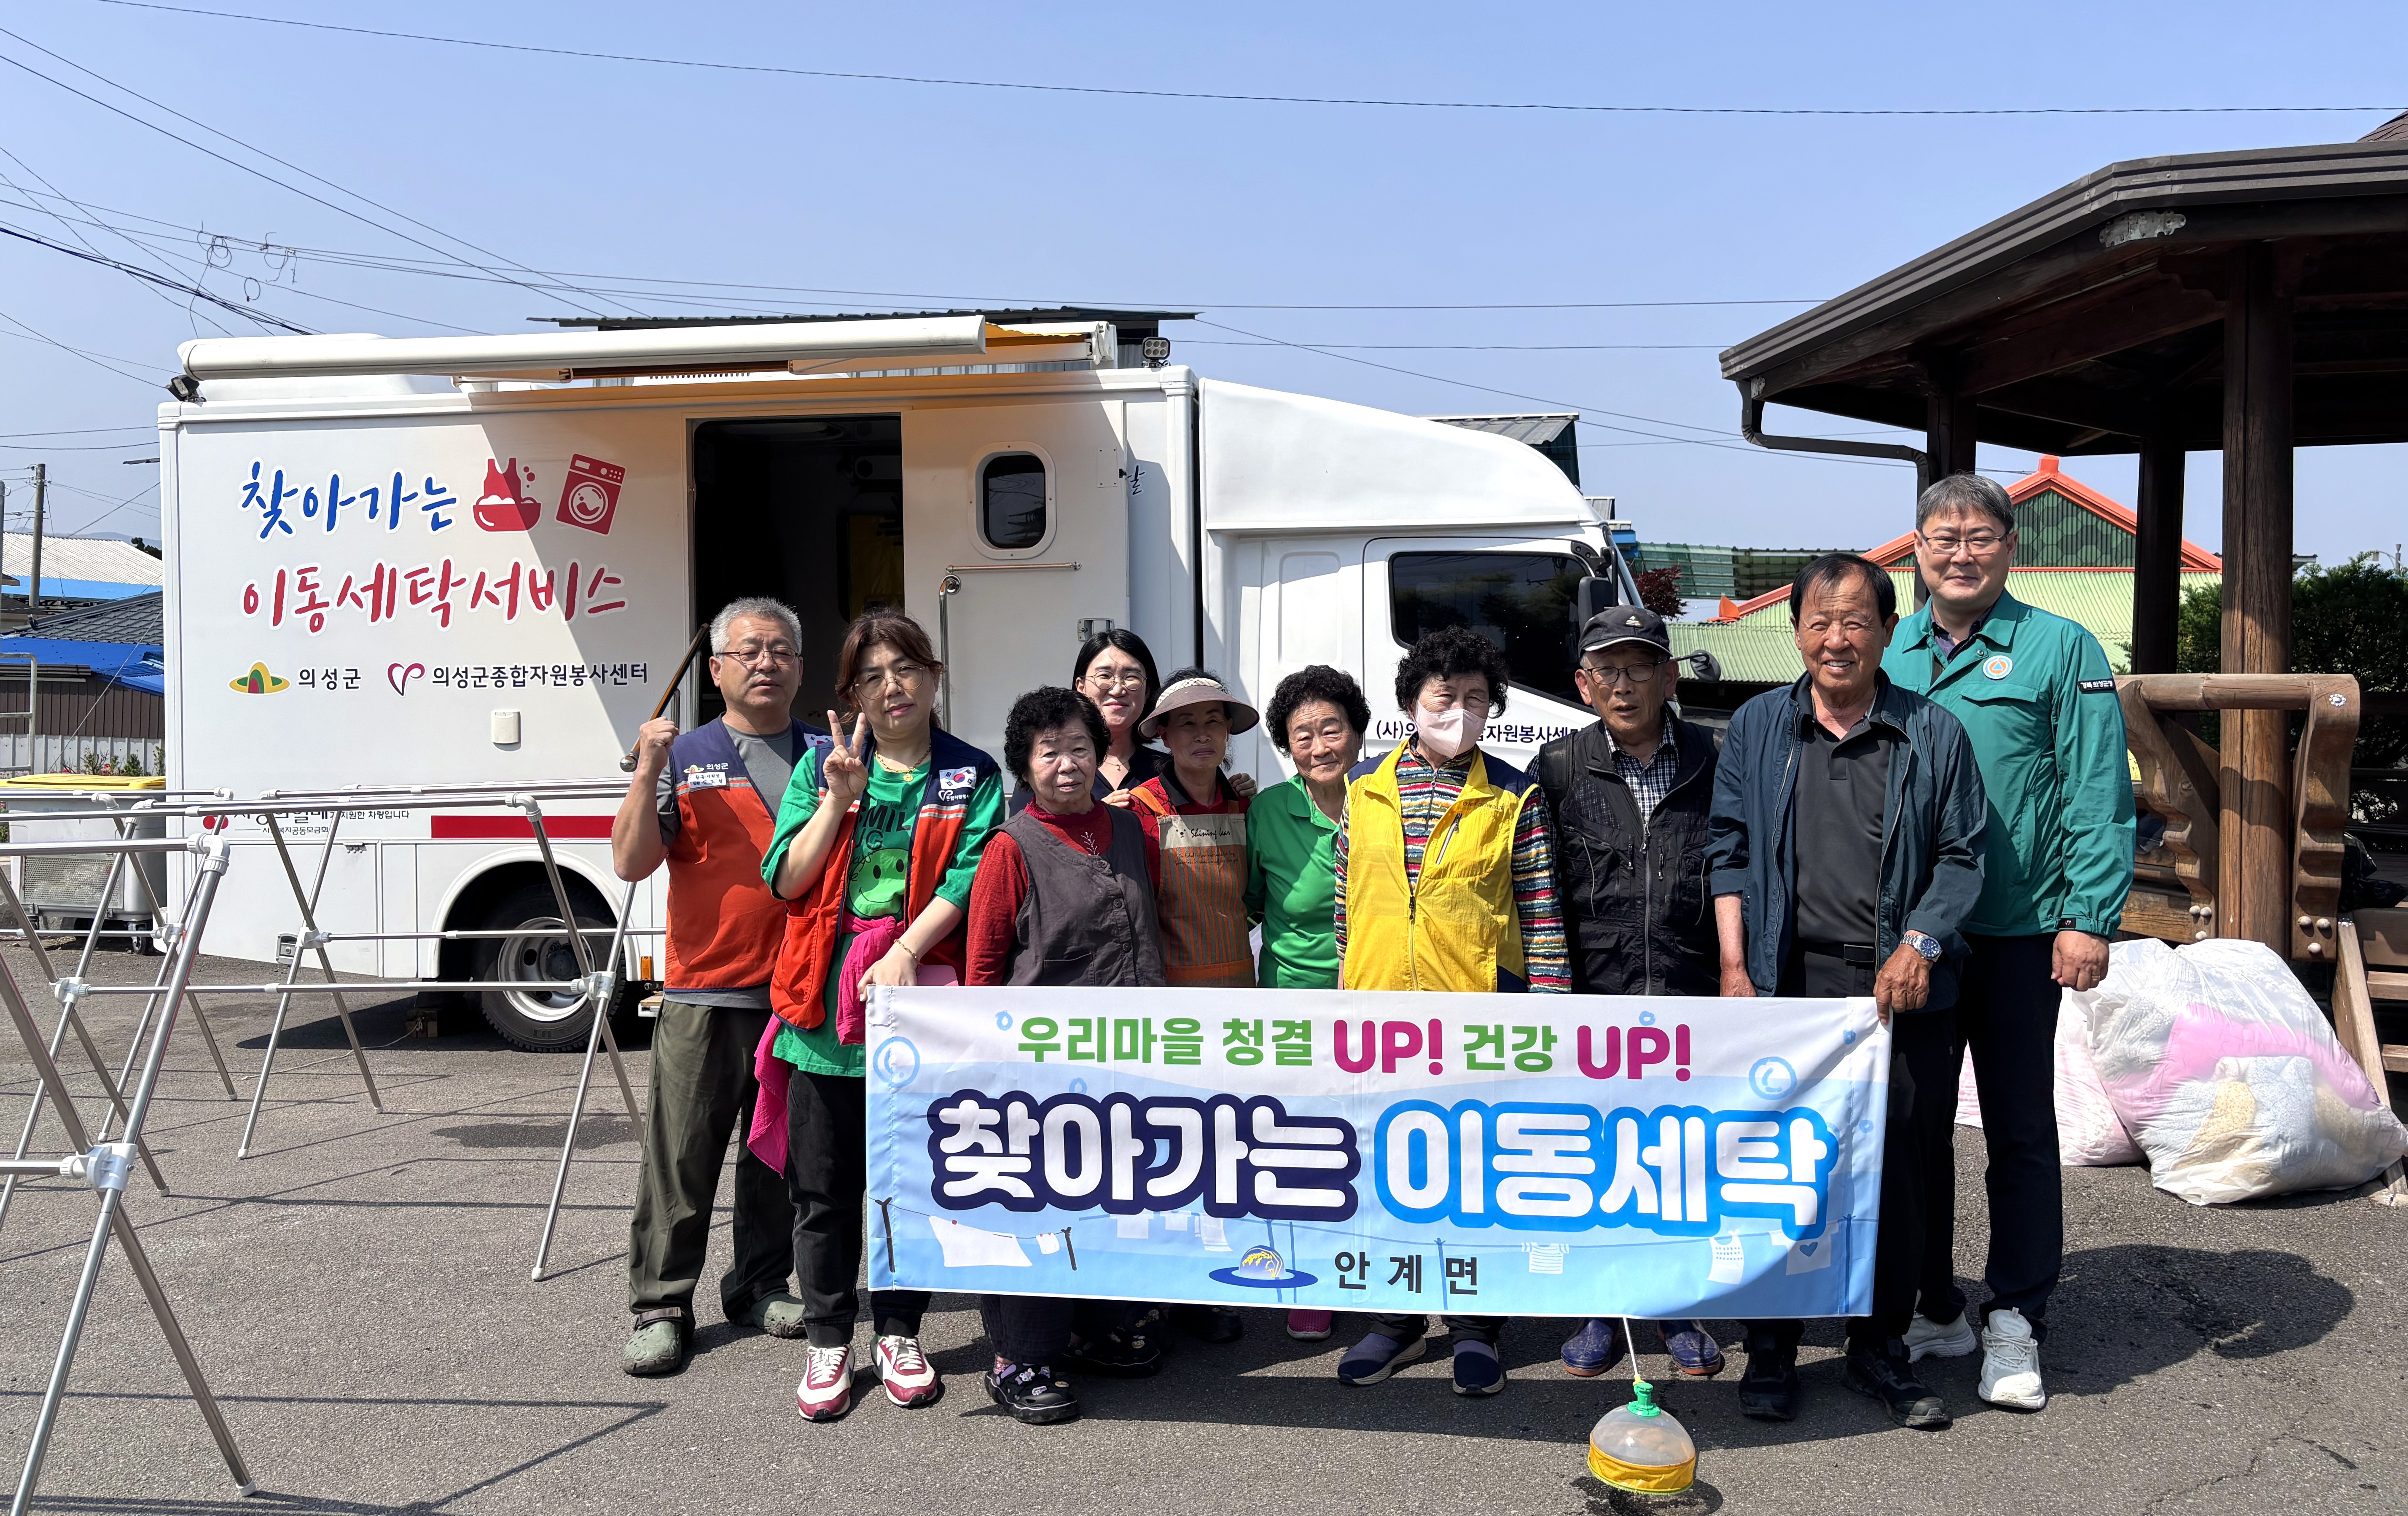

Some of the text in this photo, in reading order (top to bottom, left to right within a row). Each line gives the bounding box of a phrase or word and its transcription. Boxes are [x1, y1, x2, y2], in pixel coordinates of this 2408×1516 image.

[242, 461, 457, 540] 찾아가는
[244, 558, 626, 634] 이동세탁서비스
[298, 668, 361, 690] 의성군
[432, 663, 648, 689] 의성군종합자원봉사센터
[706, 762, 728, 770] 의성군
[368, 810, 409, 820] 차량입니다
[1191, 828, 1217, 840] Shining
[1018, 1016, 1691, 1081] 우리마을 청결 UP! 건강 UP!
[937, 1097, 1830, 1239] 찾아가는 이동세탁
